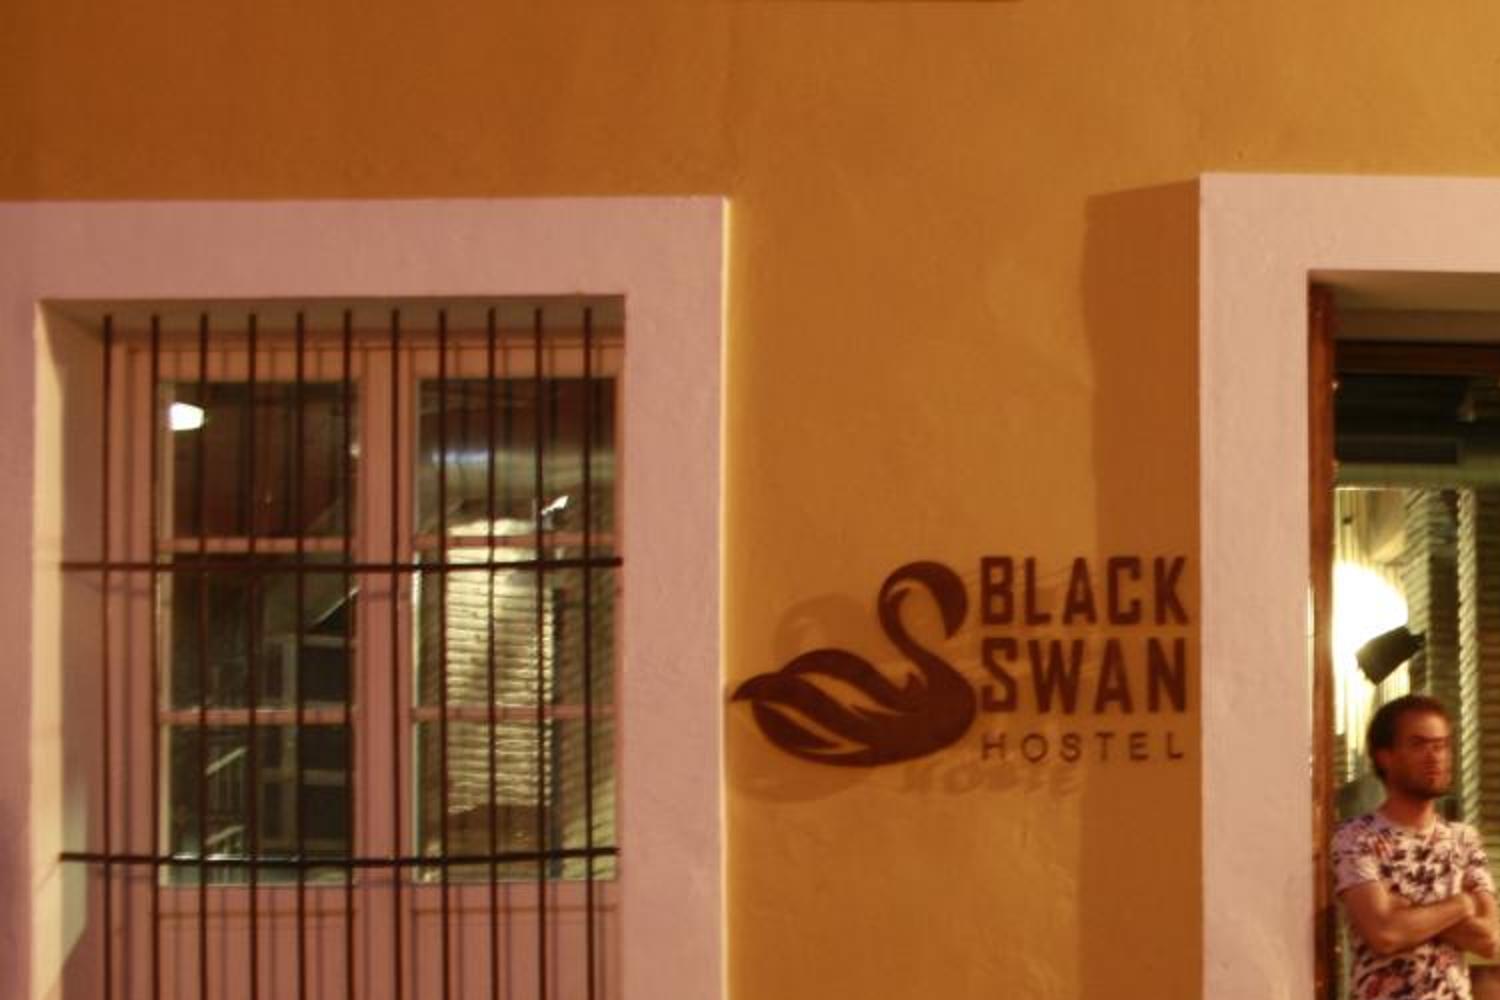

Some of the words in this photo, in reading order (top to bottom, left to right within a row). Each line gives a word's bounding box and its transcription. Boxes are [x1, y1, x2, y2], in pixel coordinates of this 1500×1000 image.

[980, 556, 1188, 626] BLACK
[980, 637, 1186, 714] SWAN
[981, 731, 1184, 764] HOSTEL
